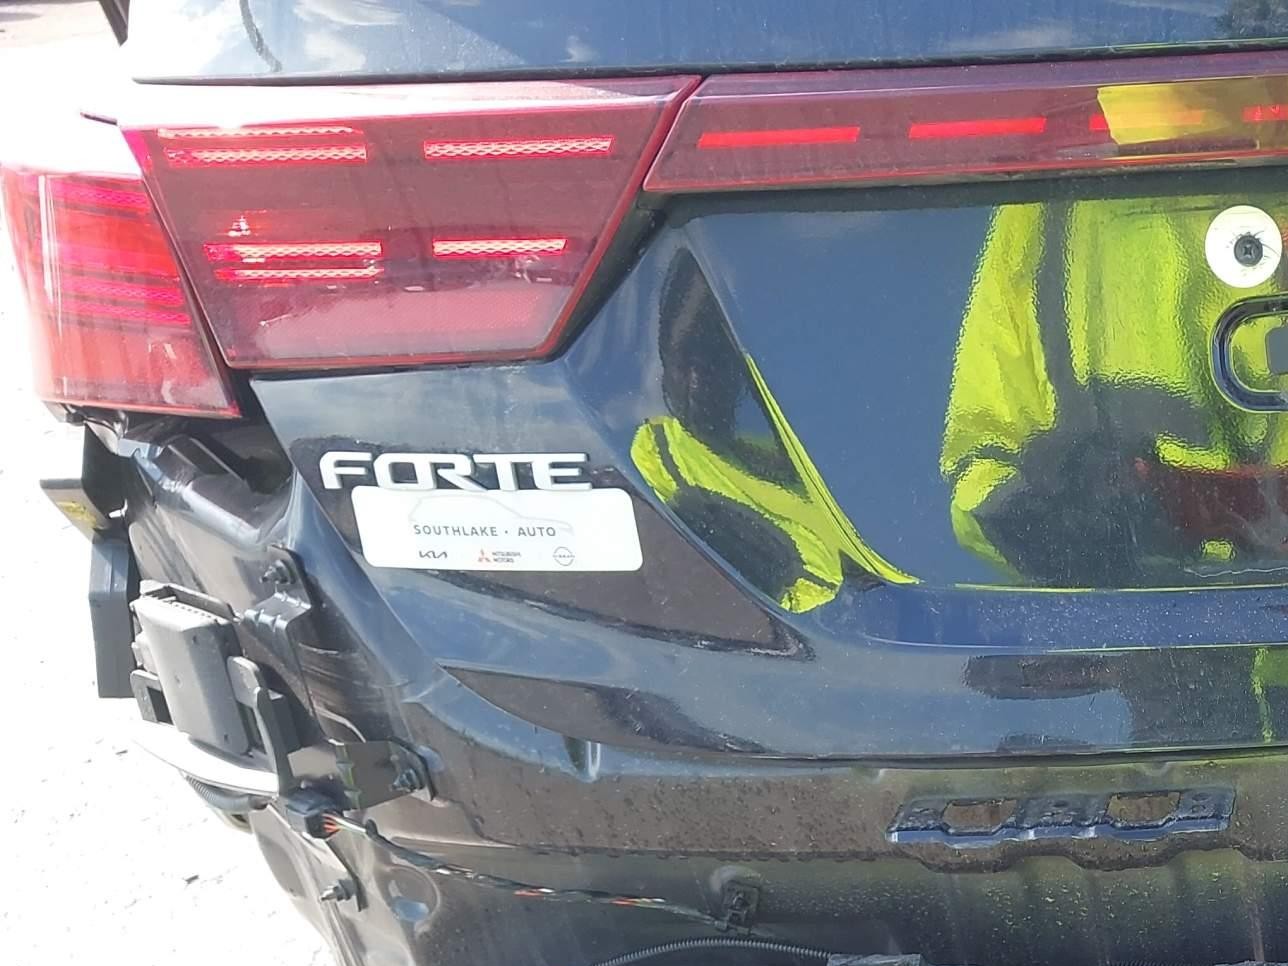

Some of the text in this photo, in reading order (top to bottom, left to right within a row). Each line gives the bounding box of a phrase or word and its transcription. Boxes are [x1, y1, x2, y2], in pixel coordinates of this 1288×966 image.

[319, 451, 593, 491] FORTE
[413, 524, 499, 537] SOUTHLAKE
[517, 526, 556, 537] AUTO
